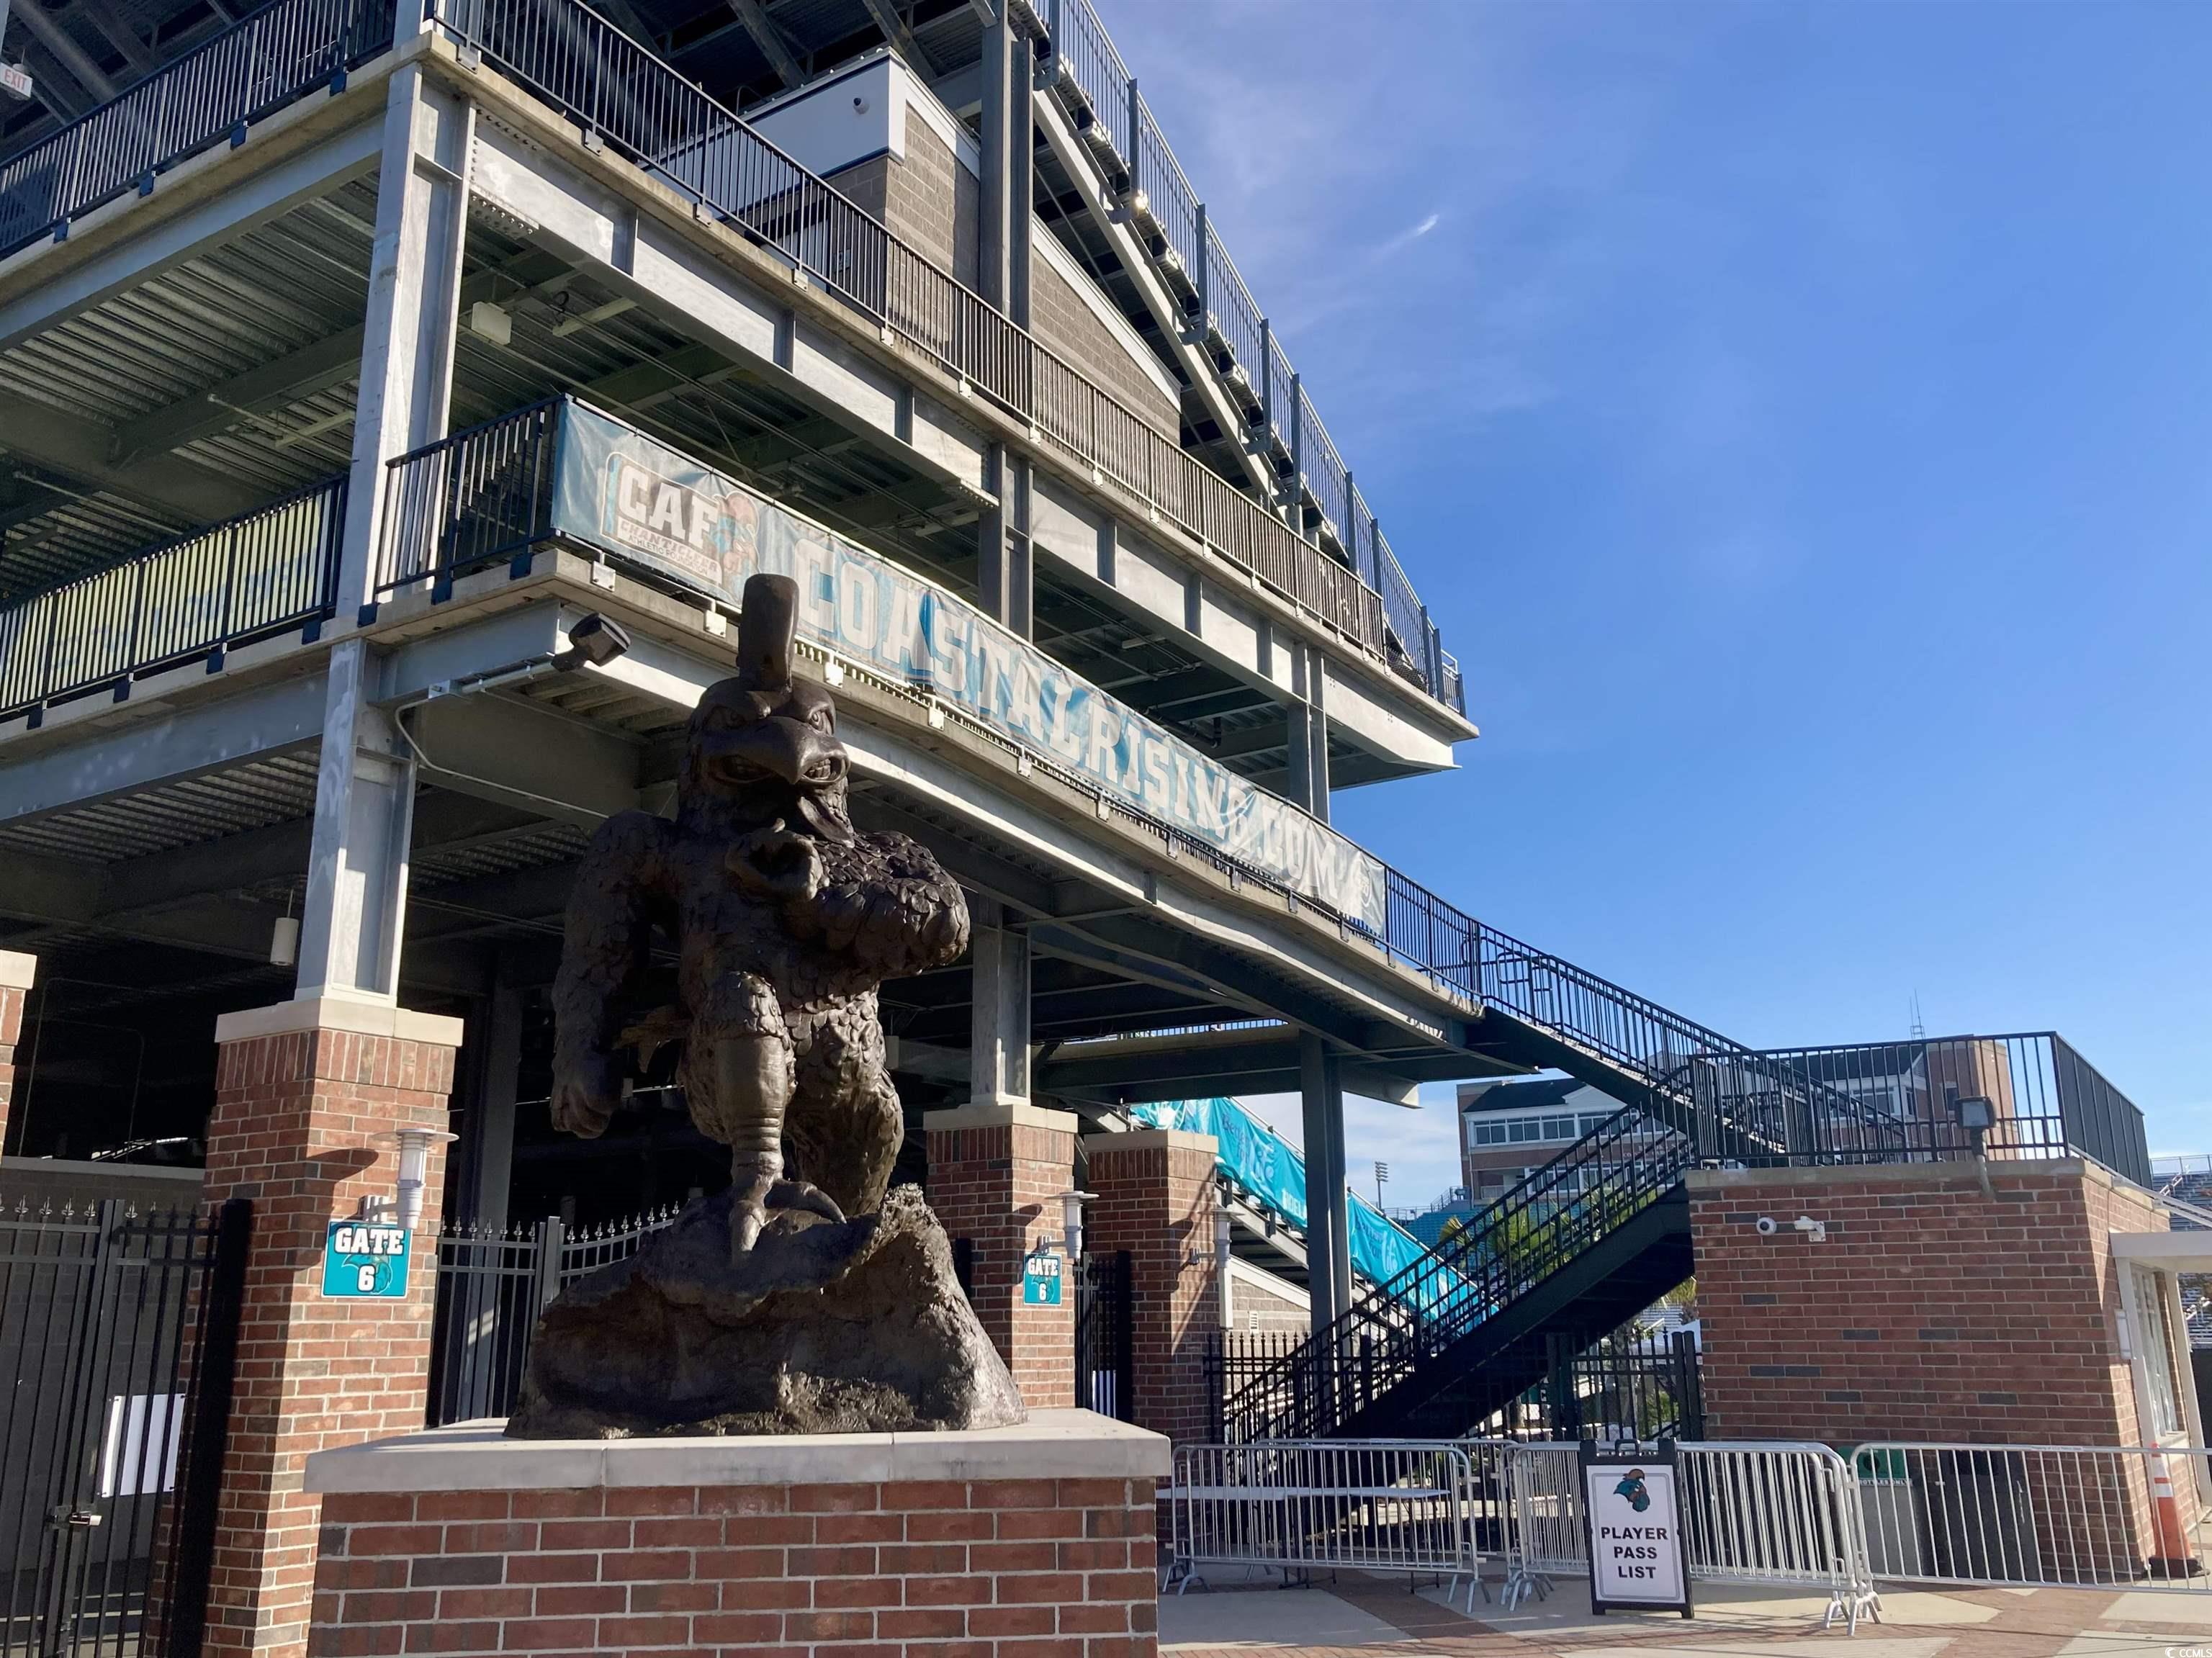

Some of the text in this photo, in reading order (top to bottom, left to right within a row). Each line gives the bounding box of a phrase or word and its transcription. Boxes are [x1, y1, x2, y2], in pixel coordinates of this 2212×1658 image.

[4, 68, 27, 90] EXIT
[619, 465, 719, 549] CAF
[620, 520, 717, 572] CHANTICLEER
[628, 536, 663, 554] ATHLETIC
[335, 1227, 404, 1255] GATE
[1028, 1257, 1058, 1276] GATE
[358, 1265, 375, 1291] 6
[1039, 1283, 1047, 1301] 6
[1601, 1527, 1668, 1540] PLAYER
[1614, 1546, 1658, 1559] PASS
[1618, 1566, 1656, 1579] LIST
